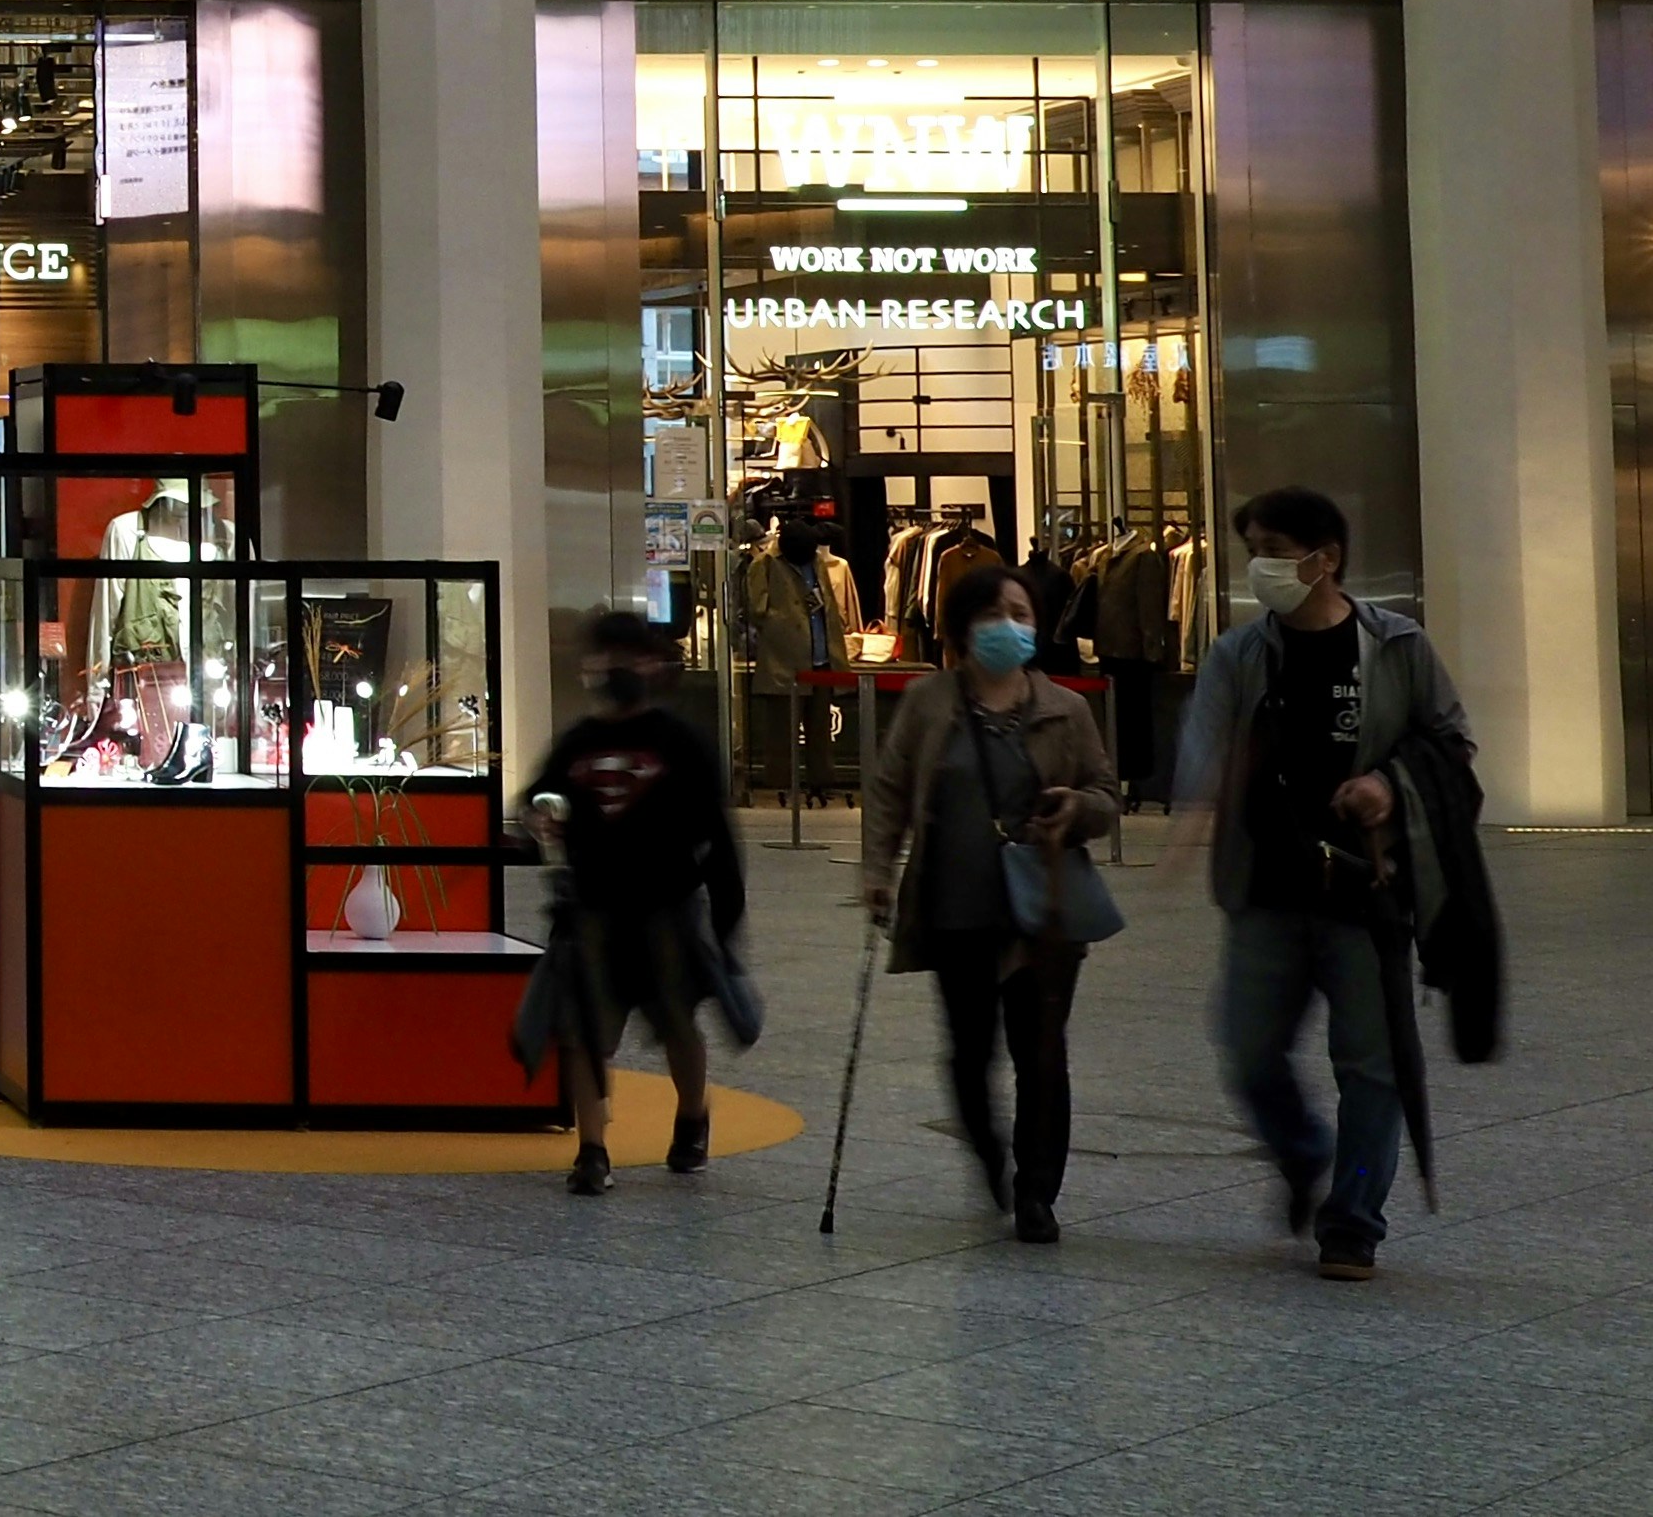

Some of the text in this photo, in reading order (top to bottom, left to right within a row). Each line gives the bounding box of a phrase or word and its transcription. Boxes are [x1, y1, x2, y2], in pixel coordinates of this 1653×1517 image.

[769, 246, 1038, 274] WORK NOT WORK
[727, 297, 1086, 330] URBAN RESEARCH
